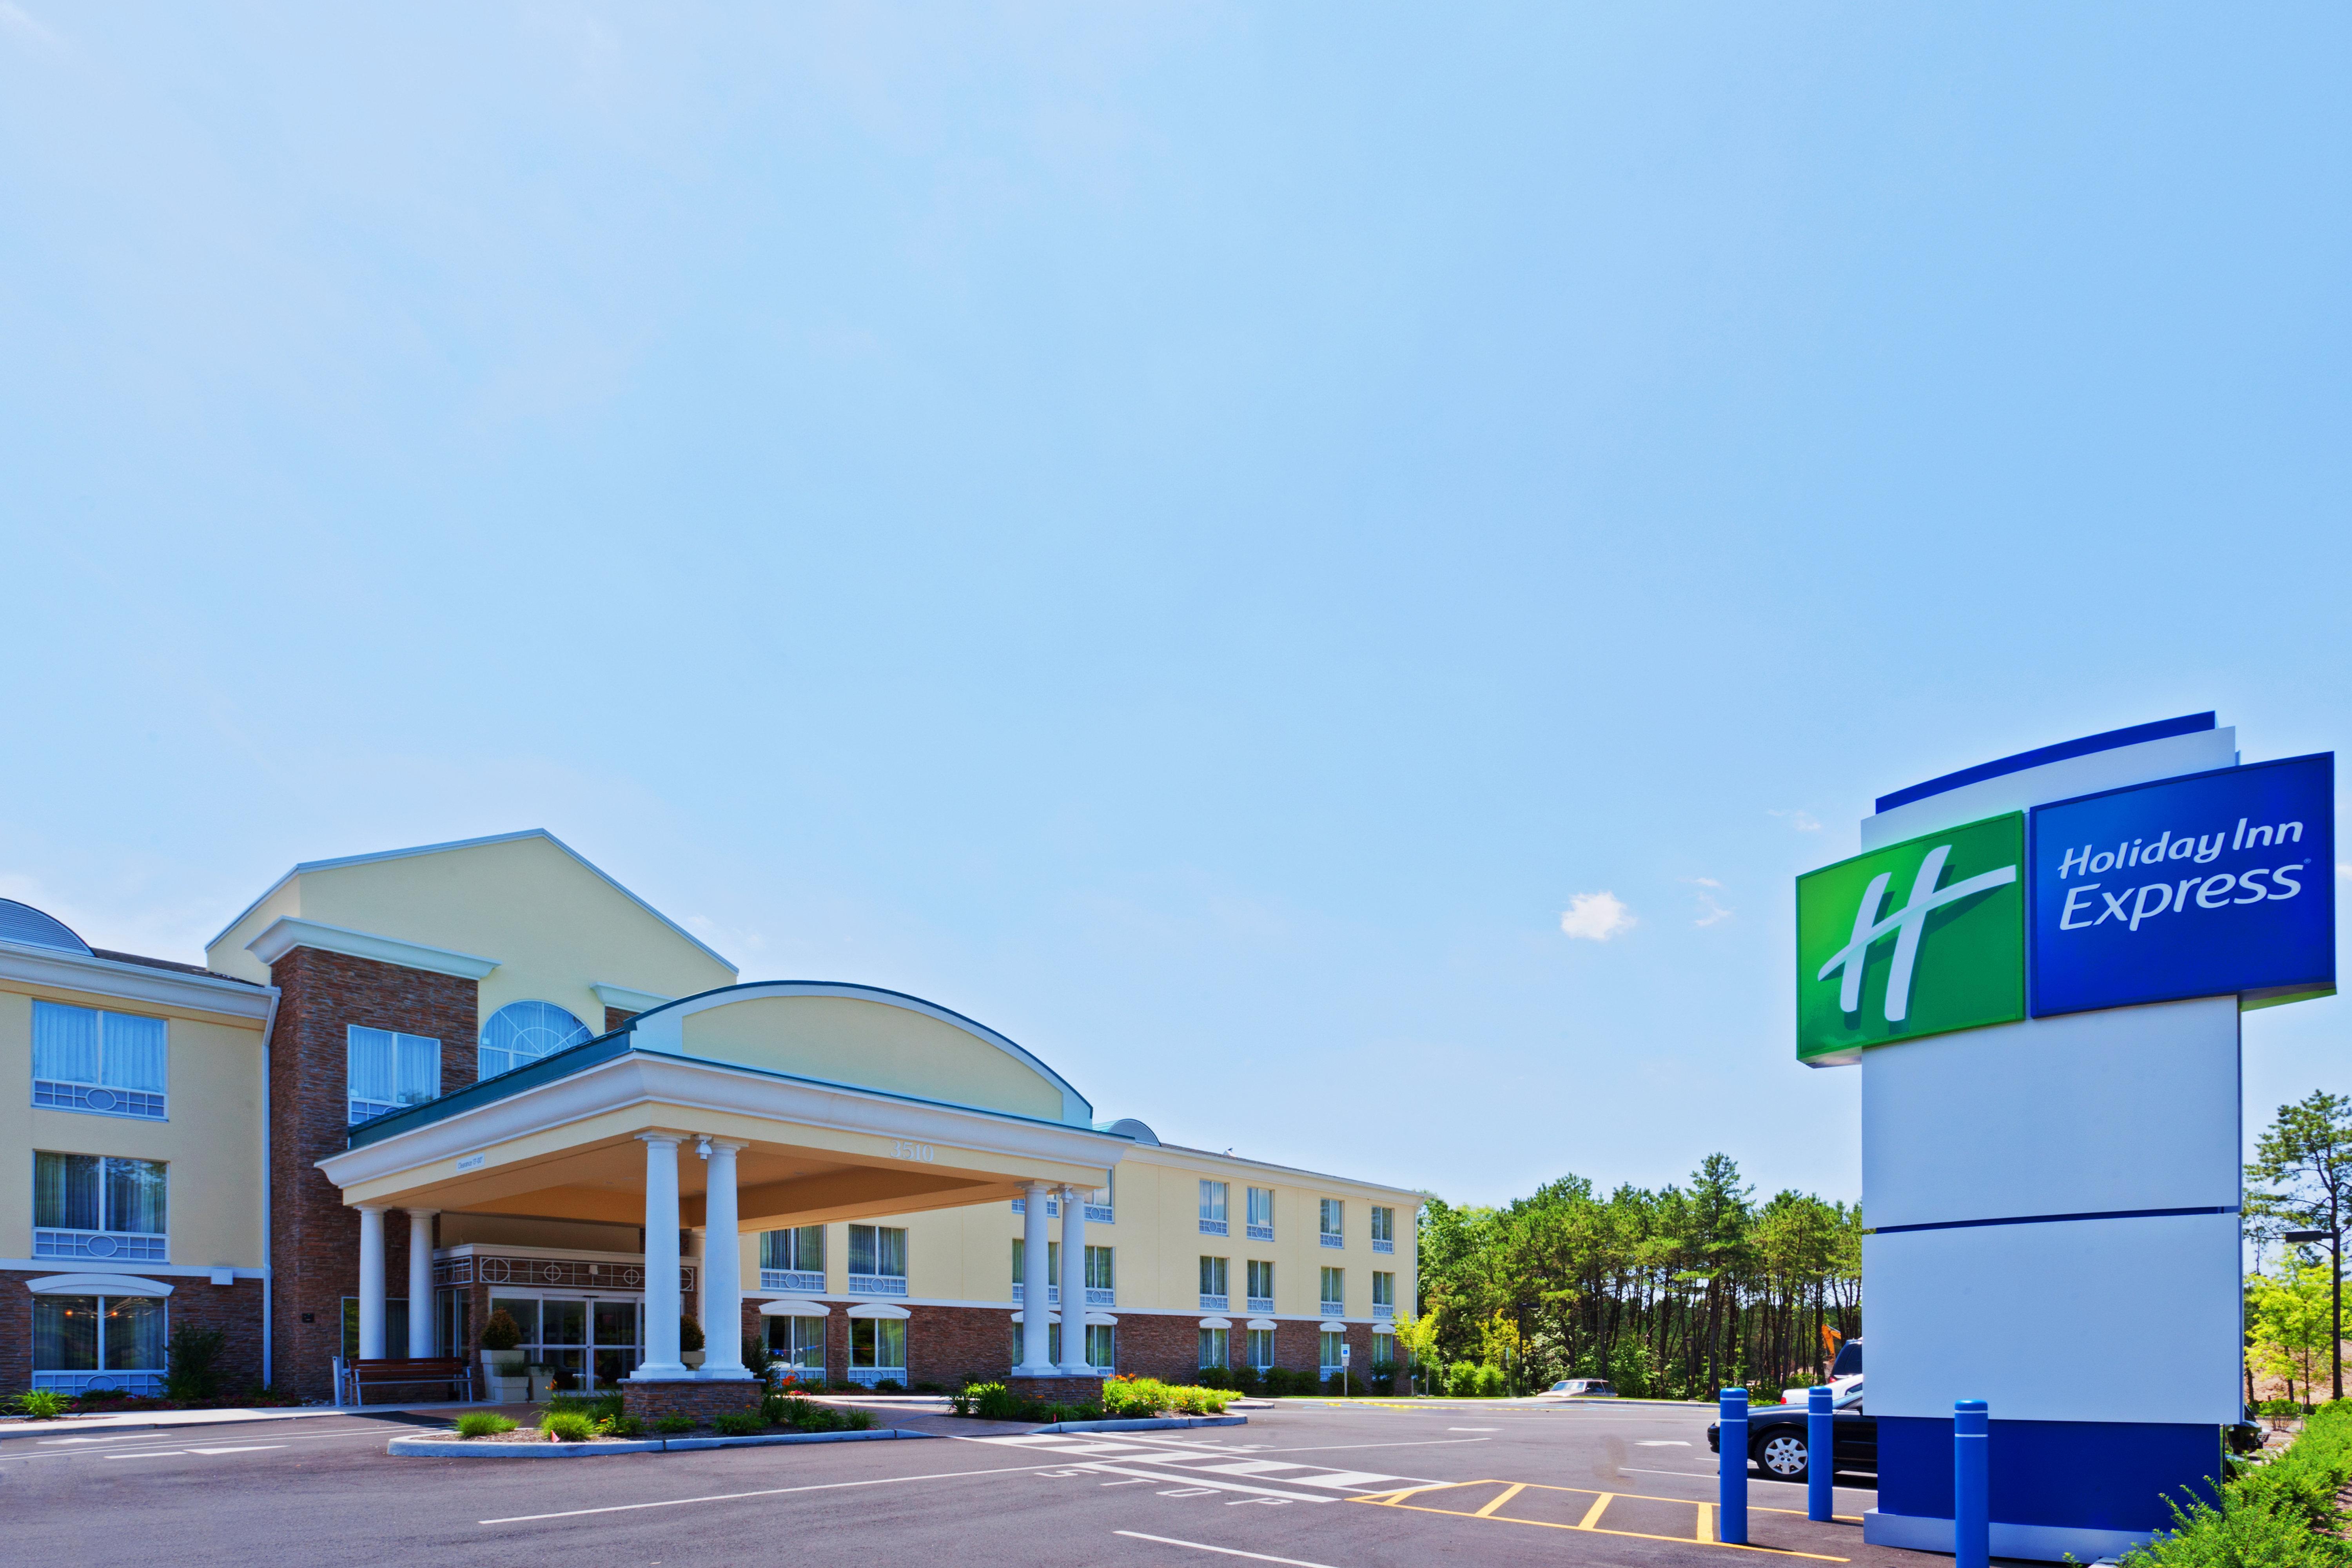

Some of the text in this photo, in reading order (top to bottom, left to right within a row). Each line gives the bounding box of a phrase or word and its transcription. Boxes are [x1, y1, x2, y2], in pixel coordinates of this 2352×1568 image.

[2057, 818, 2303, 879] Holiday Inn
[2059, 864, 2304, 931] Express
[890, 1140, 934, 1162] 3510
[1101, 1432, 1276, 1448] STOP
[1034, 1469, 1294, 1505] STOP
